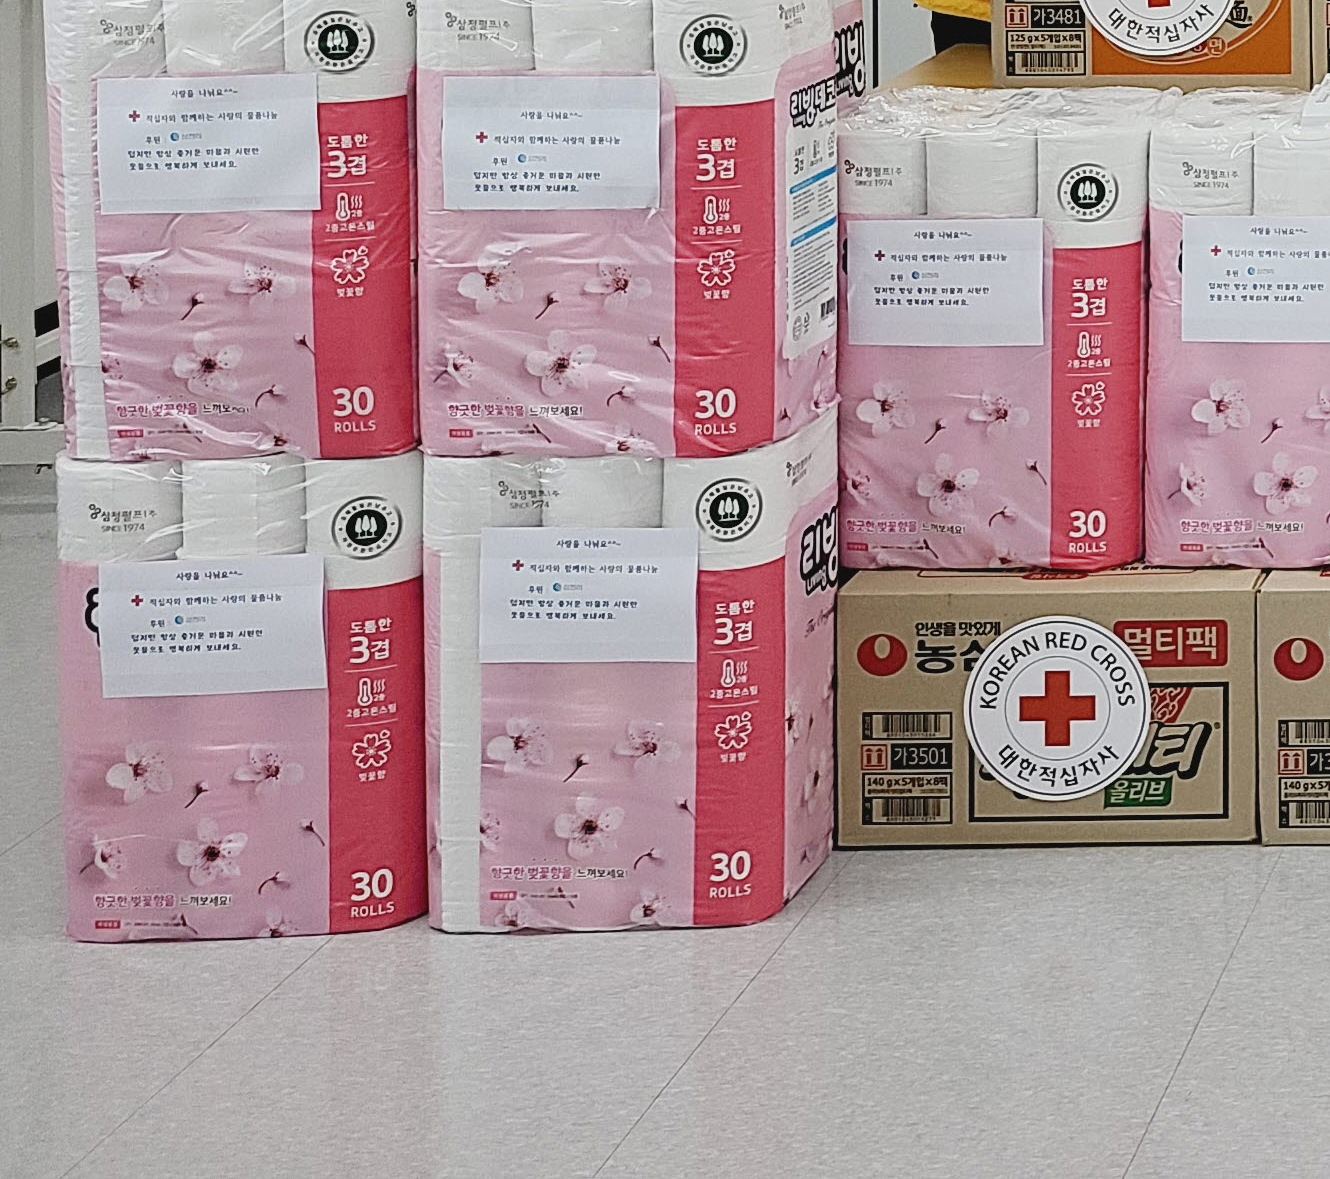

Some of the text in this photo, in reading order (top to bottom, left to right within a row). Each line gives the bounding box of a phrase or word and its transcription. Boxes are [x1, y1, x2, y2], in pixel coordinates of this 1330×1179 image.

[1108, 3, 1215, 44] 대한적십자사
[171, 89, 194, 99] 사랑을
[218, 111, 243, 120] 사랑의
[327, 134, 369, 150] 도톰한
[326, 150, 367, 178] 3겹
[1071, 277, 1109, 292] 도톰한
[1070, 292, 1106, 318] 3겹
[332, 386, 375, 417] 30
[694, 388, 736, 419] 30
[333, 419, 377, 433] ROLLS
[694, 421, 737, 436] ROLLS
[123, 523, 145, 532] 1974
[1069, 510, 1106, 538] 30
[1068, 540, 1107, 554] ROLLS
[914, 621, 1001, 636] 인생을 맛있게
[979, 631, 1136, 710] KOREAN RED CROSS
[894, 747, 948, 766] 가3501
[998, 743, 1120, 788] 대한적십자사
[1109, 780, 1166, 804] 올리브
[709, 850, 752, 883] 30
[350, 868, 394, 902] 30
[709, 883, 752, 899] ROLLS
